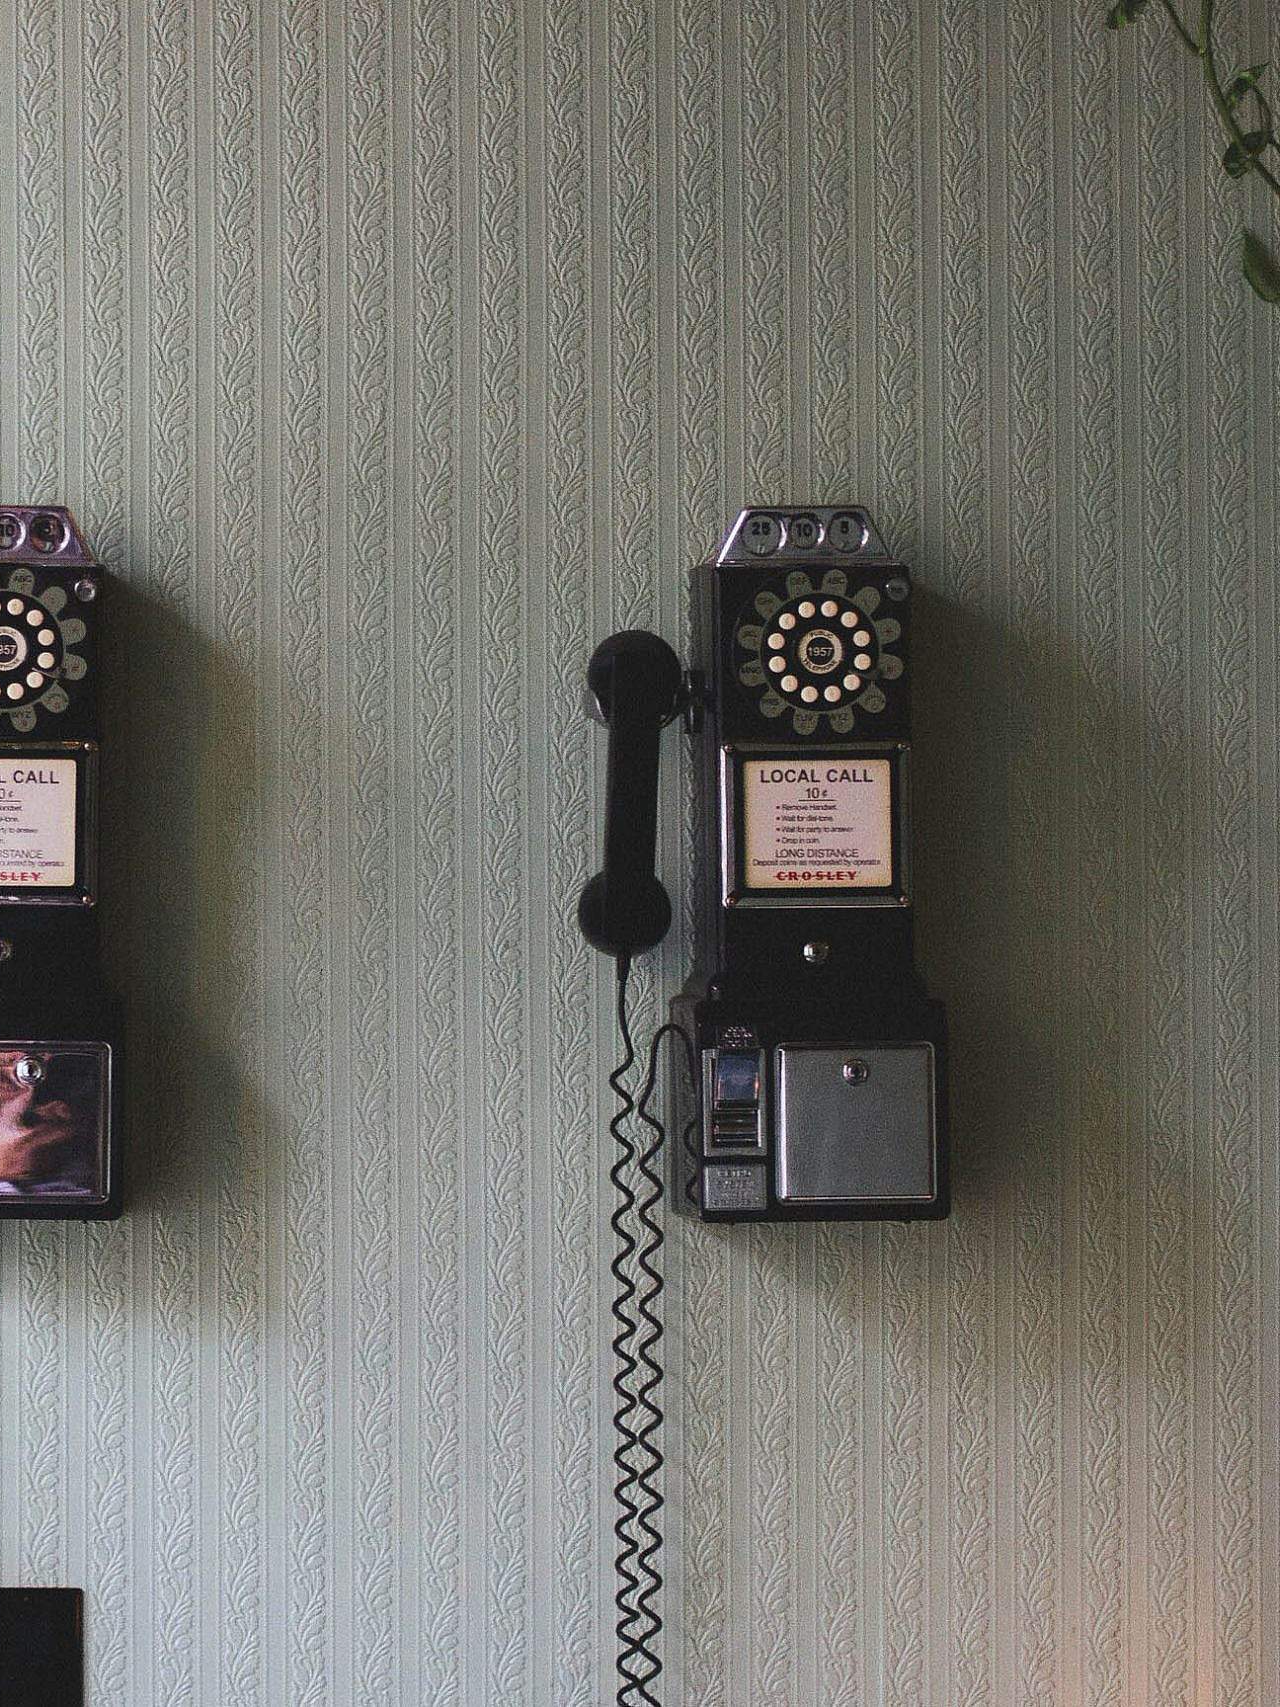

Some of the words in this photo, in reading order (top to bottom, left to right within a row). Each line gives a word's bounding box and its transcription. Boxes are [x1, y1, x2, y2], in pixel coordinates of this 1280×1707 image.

[752, 522, 771, 536] 25
[797, 524, 814, 538] 10
[807, 647, 833, 657] 1957
[13, 770, 60, 784] CALL
[760, 769, 820, 783] LOCAL
[826, 769, 873, 783] CALL
[806, 787, 820, 799] 10
[775, 849, 804, 858] LONG
[807, 849, 859, 858] DISTANCE
[775, 871, 857, 881] CROSLEY
